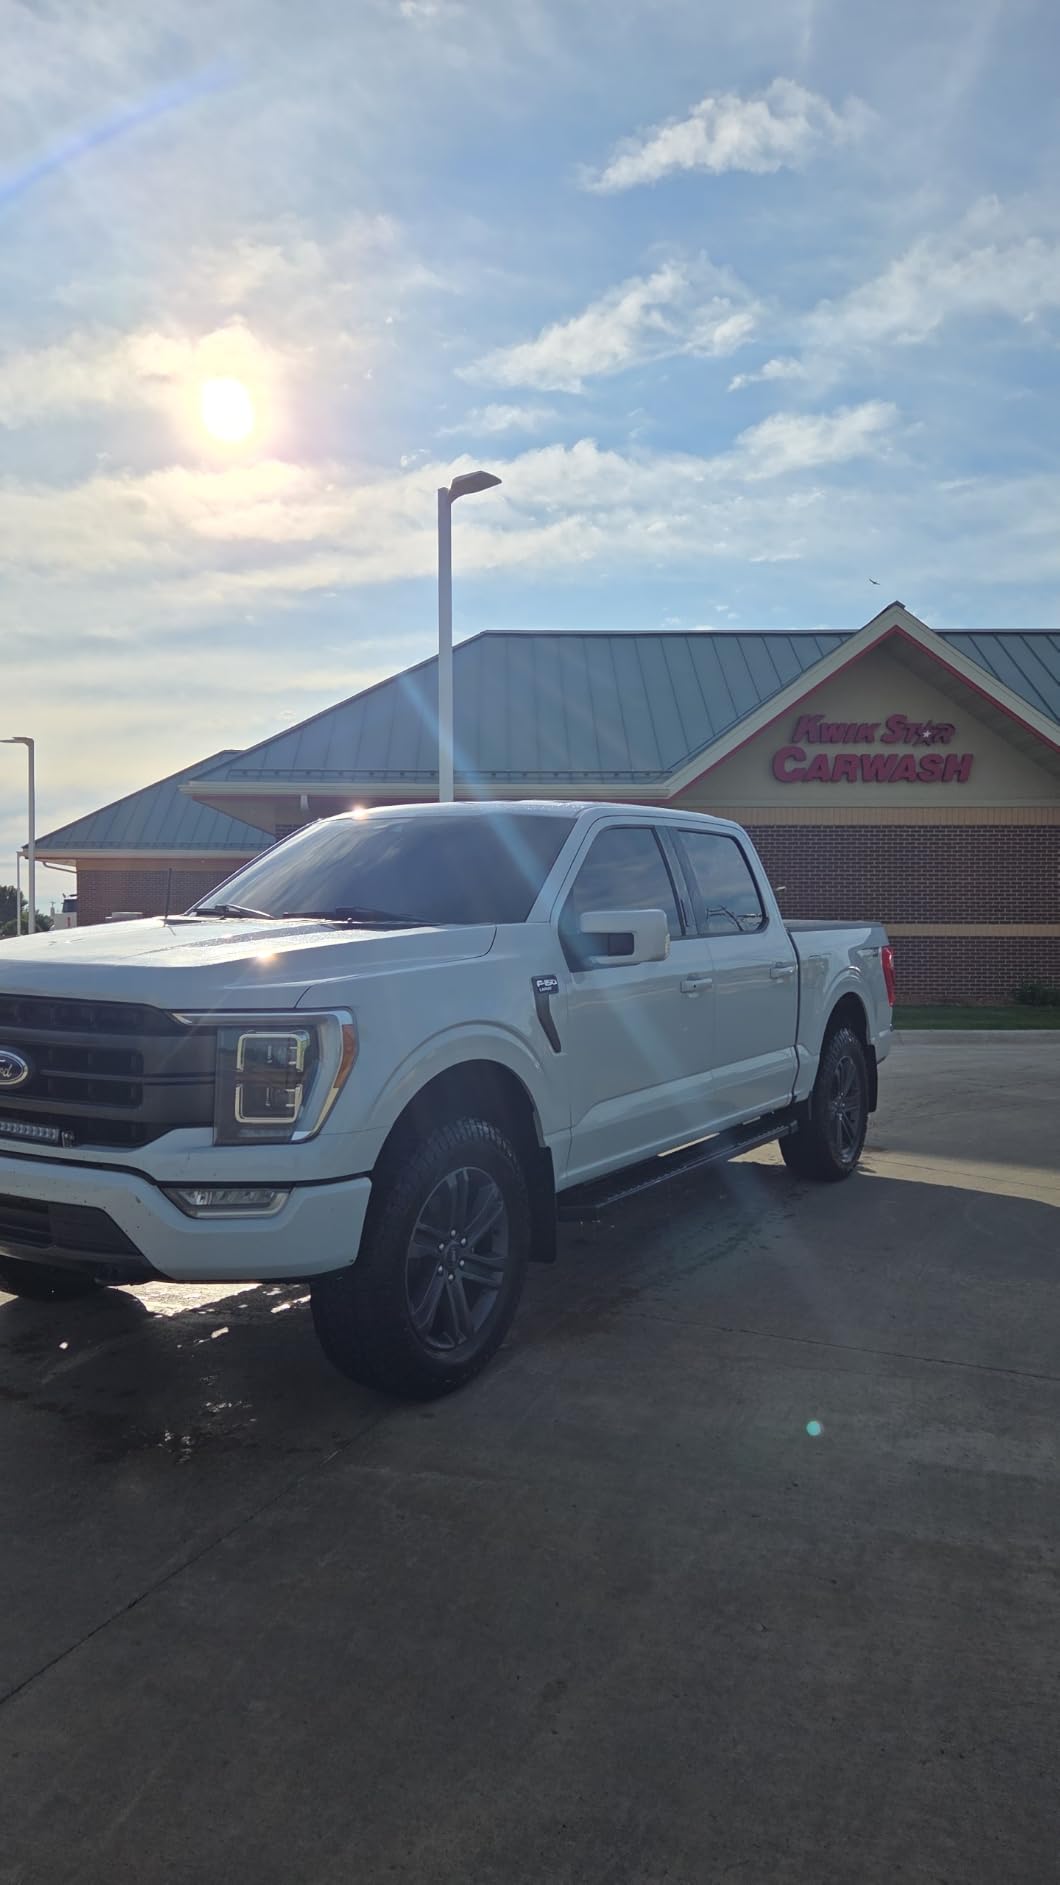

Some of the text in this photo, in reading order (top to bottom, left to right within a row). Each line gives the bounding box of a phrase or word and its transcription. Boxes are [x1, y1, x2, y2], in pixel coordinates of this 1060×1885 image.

[792, 714, 955, 747] KWIK STAR
[772, 746, 973, 783] CARWASH
